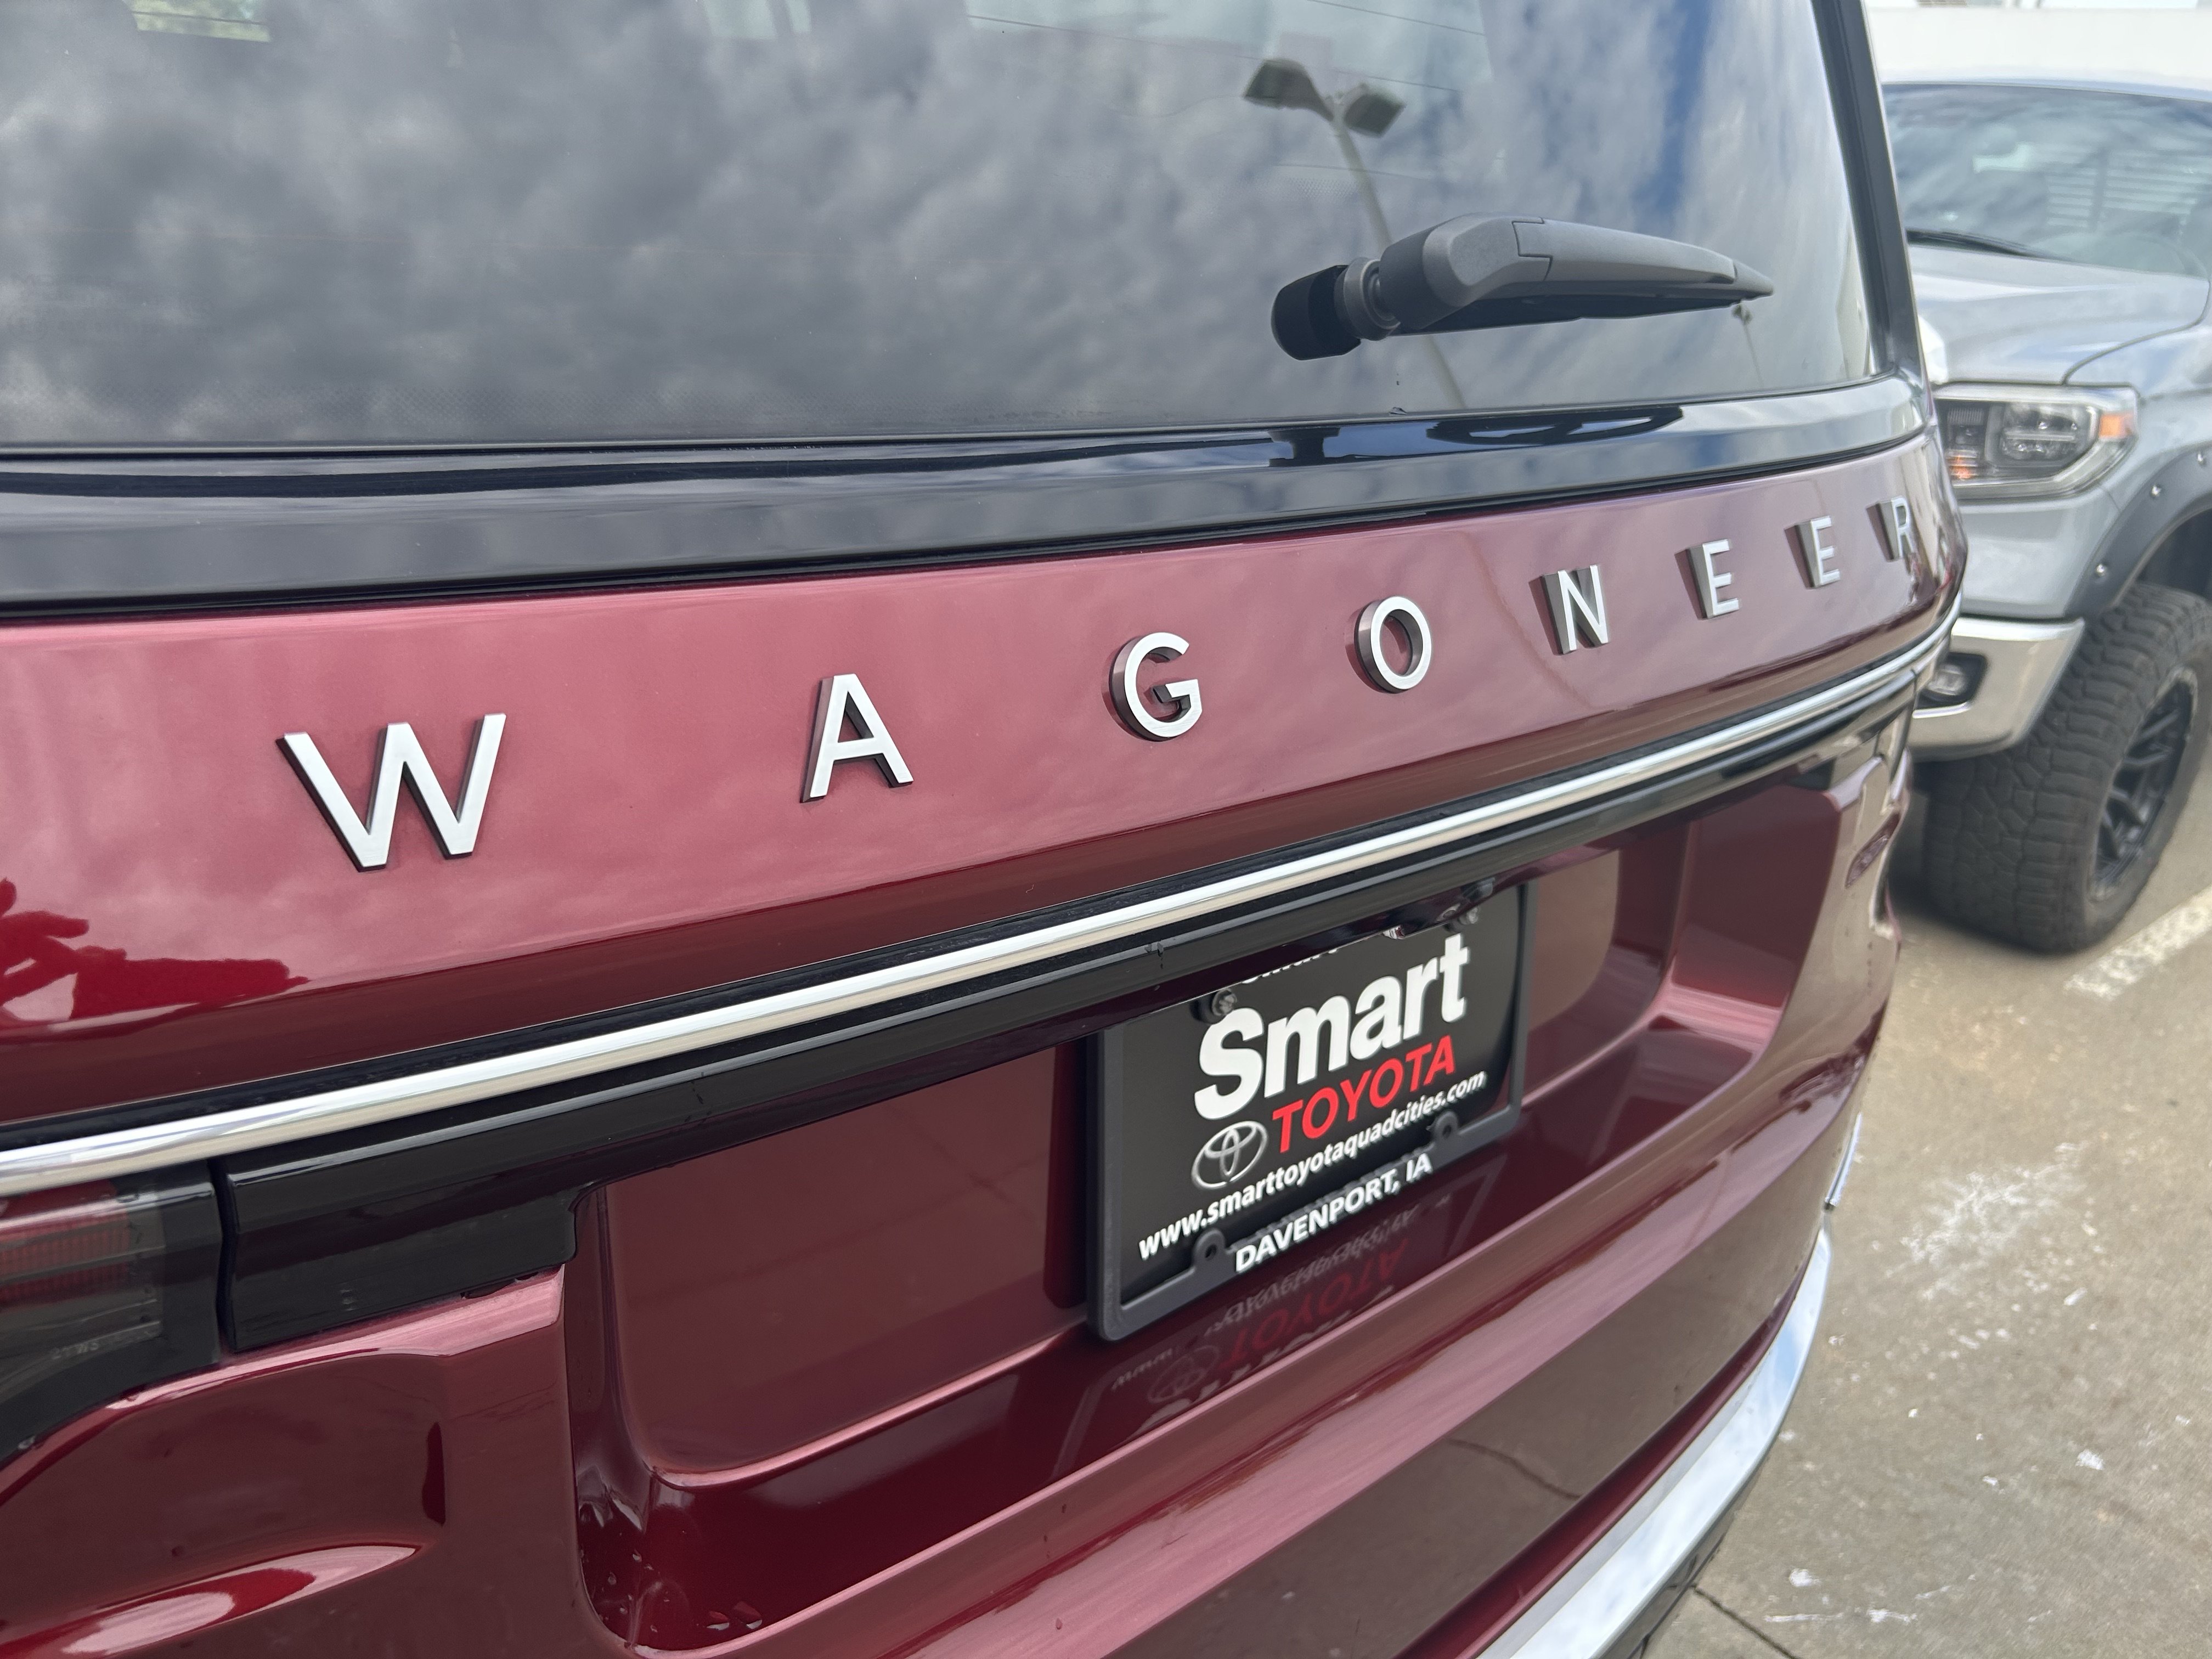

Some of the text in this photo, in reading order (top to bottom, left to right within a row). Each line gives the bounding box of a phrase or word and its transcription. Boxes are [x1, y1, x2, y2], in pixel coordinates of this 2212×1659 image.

[278, 496, 1911, 871] WAGONEER
[1194, 934, 1470, 1120] Smart
[1272, 1035, 1455, 1153] TOYOTA
[1138, 1070, 1487, 1260] www.smarttoyotaquadcities.com
[1235, 1167, 1401, 1274] DAVENPORT,
[1406, 1152, 1434, 1183] IA
